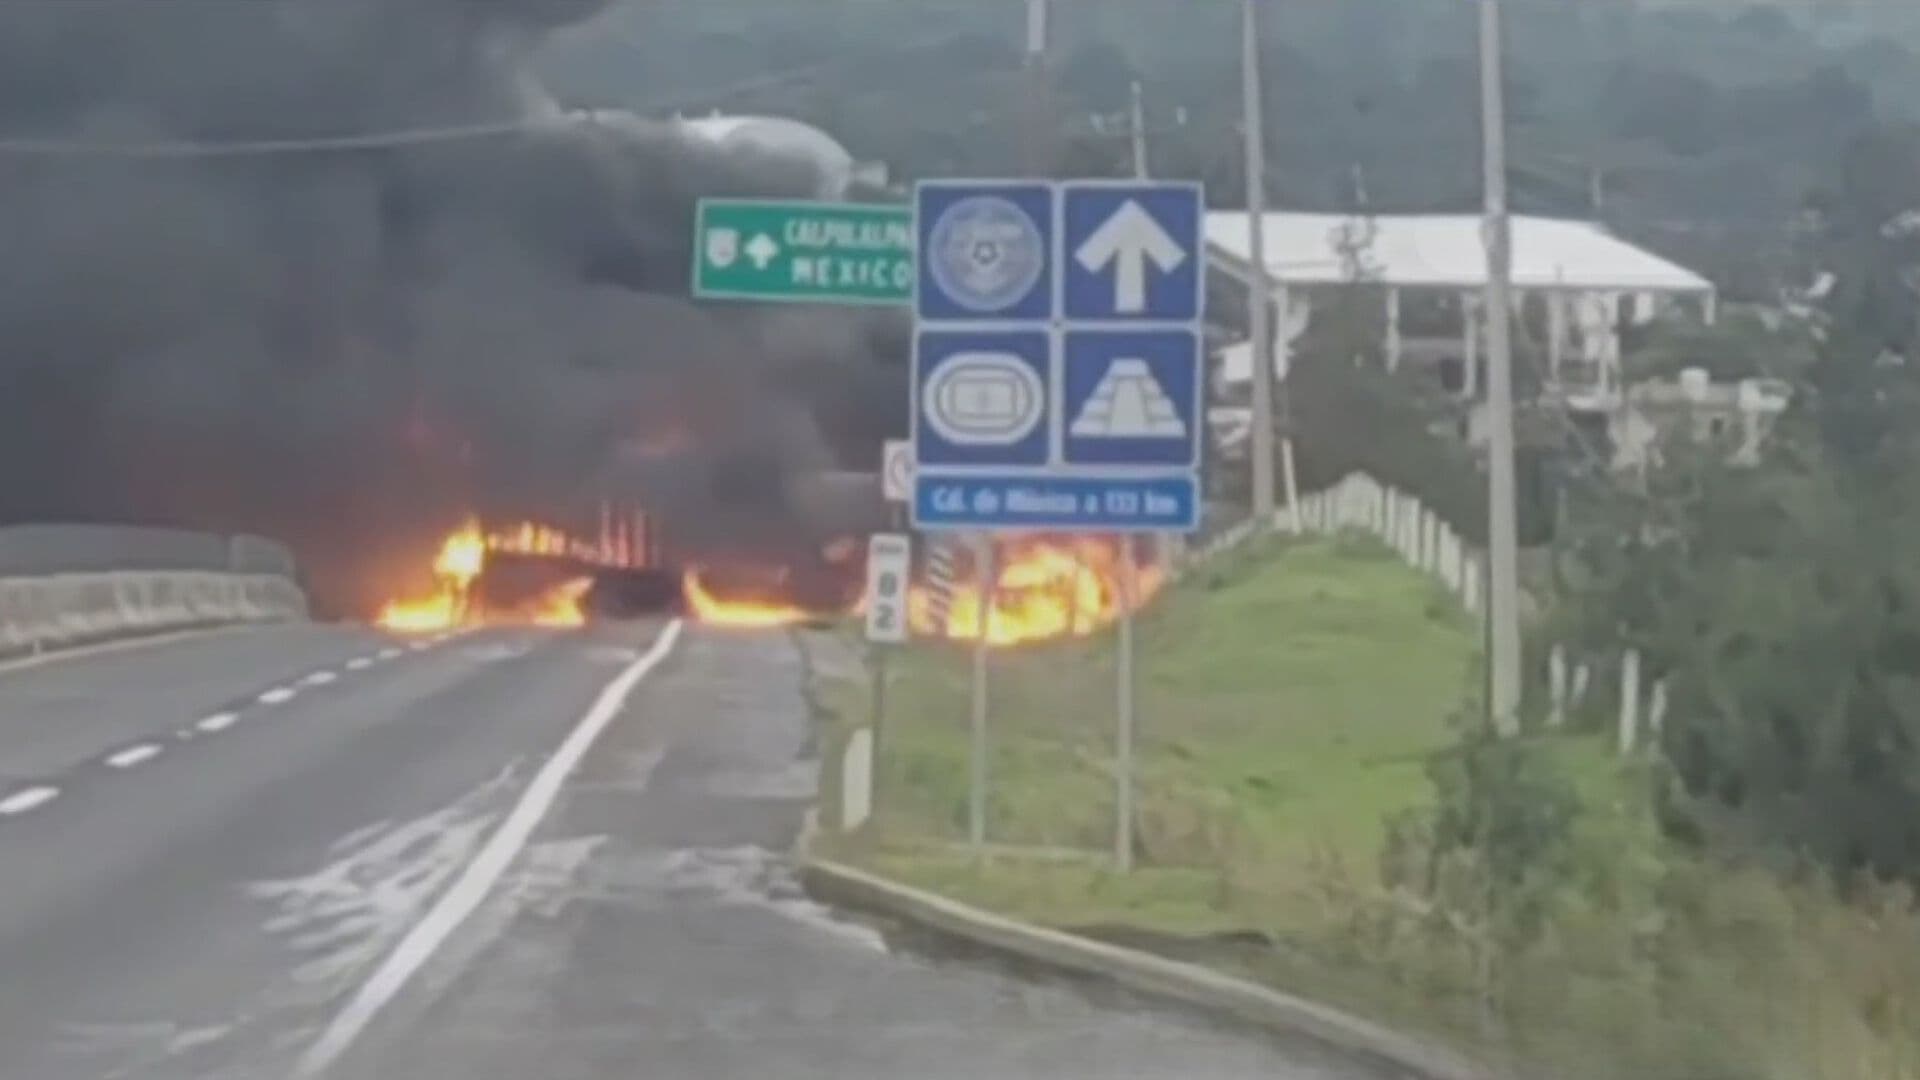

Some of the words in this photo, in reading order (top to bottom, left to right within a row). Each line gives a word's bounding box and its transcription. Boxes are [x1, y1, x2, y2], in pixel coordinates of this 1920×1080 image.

[973, 488, 998, 513] de
[1085, 495, 1098, 513] a
[1145, 491, 1178, 515] km
